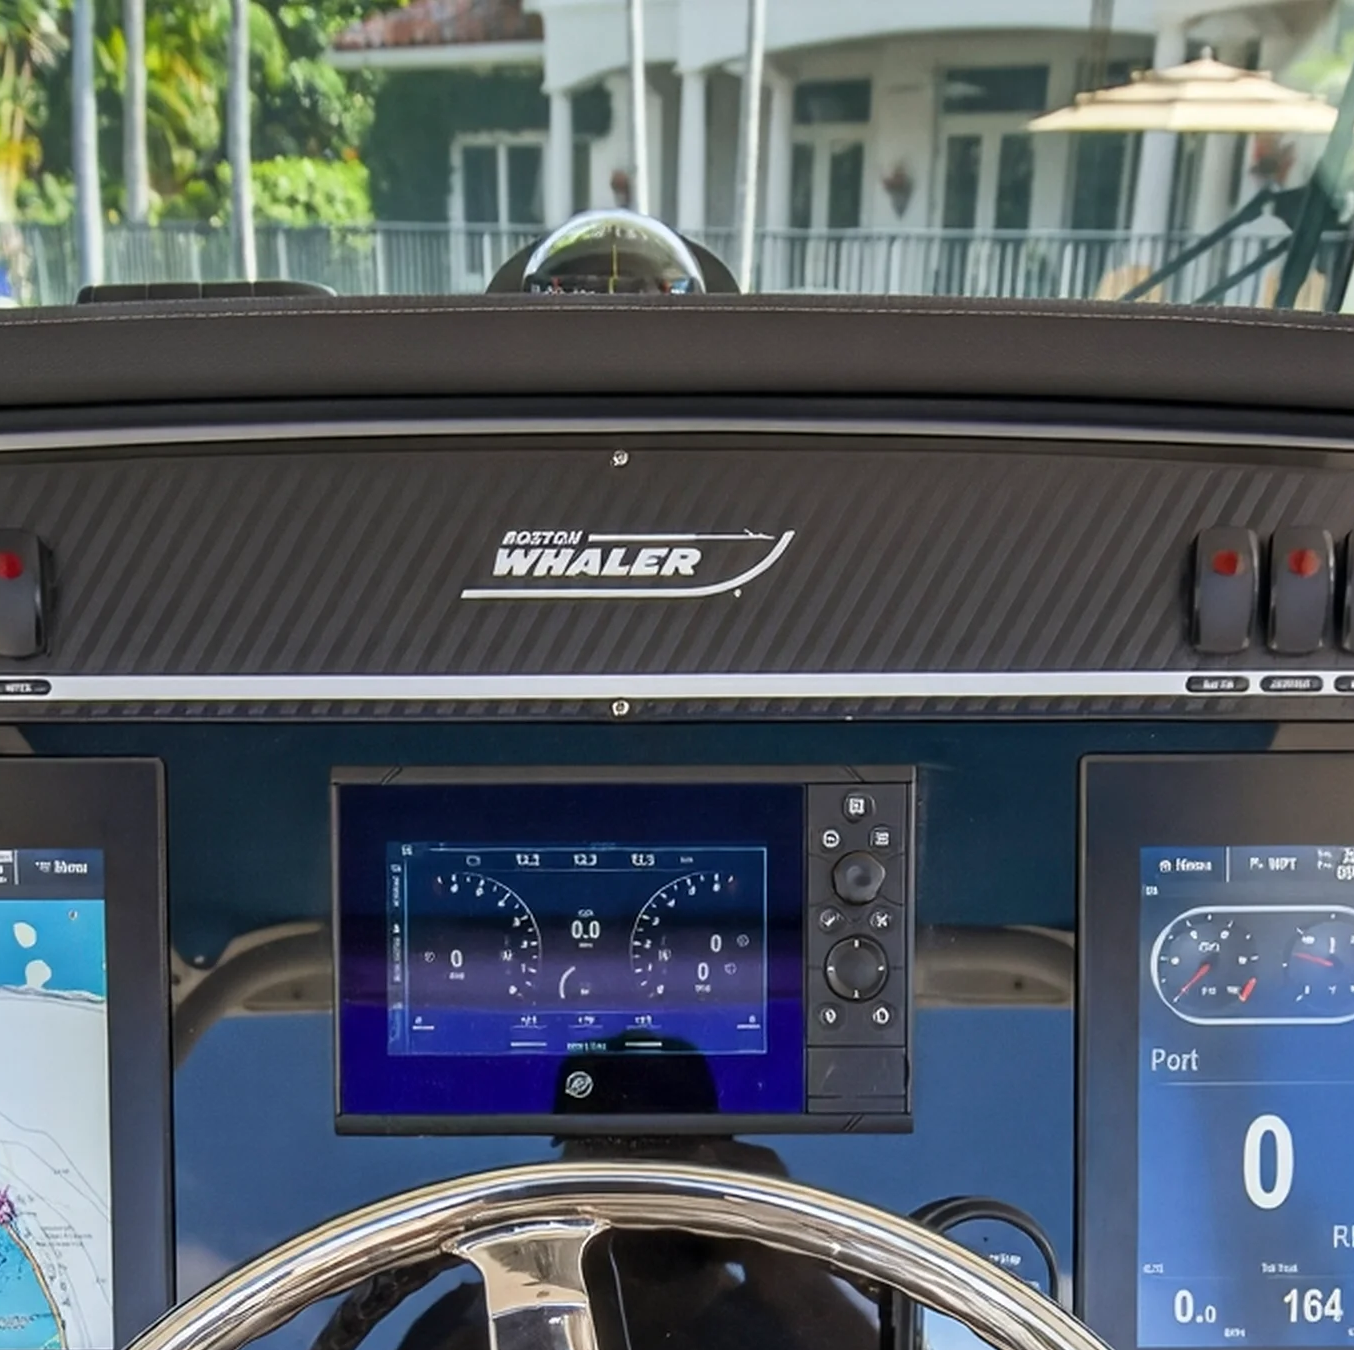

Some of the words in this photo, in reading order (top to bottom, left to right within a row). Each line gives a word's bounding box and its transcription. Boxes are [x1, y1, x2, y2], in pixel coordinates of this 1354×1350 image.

[493, 547, 702, 576] WHALER
[1150, 1048, 1199, 1072] Port
[1243, 1114, 1294, 1209] 0
[1173, 1289, 1217, 1324] 0.0
[1283, 1287, 1344, 1323] 164
